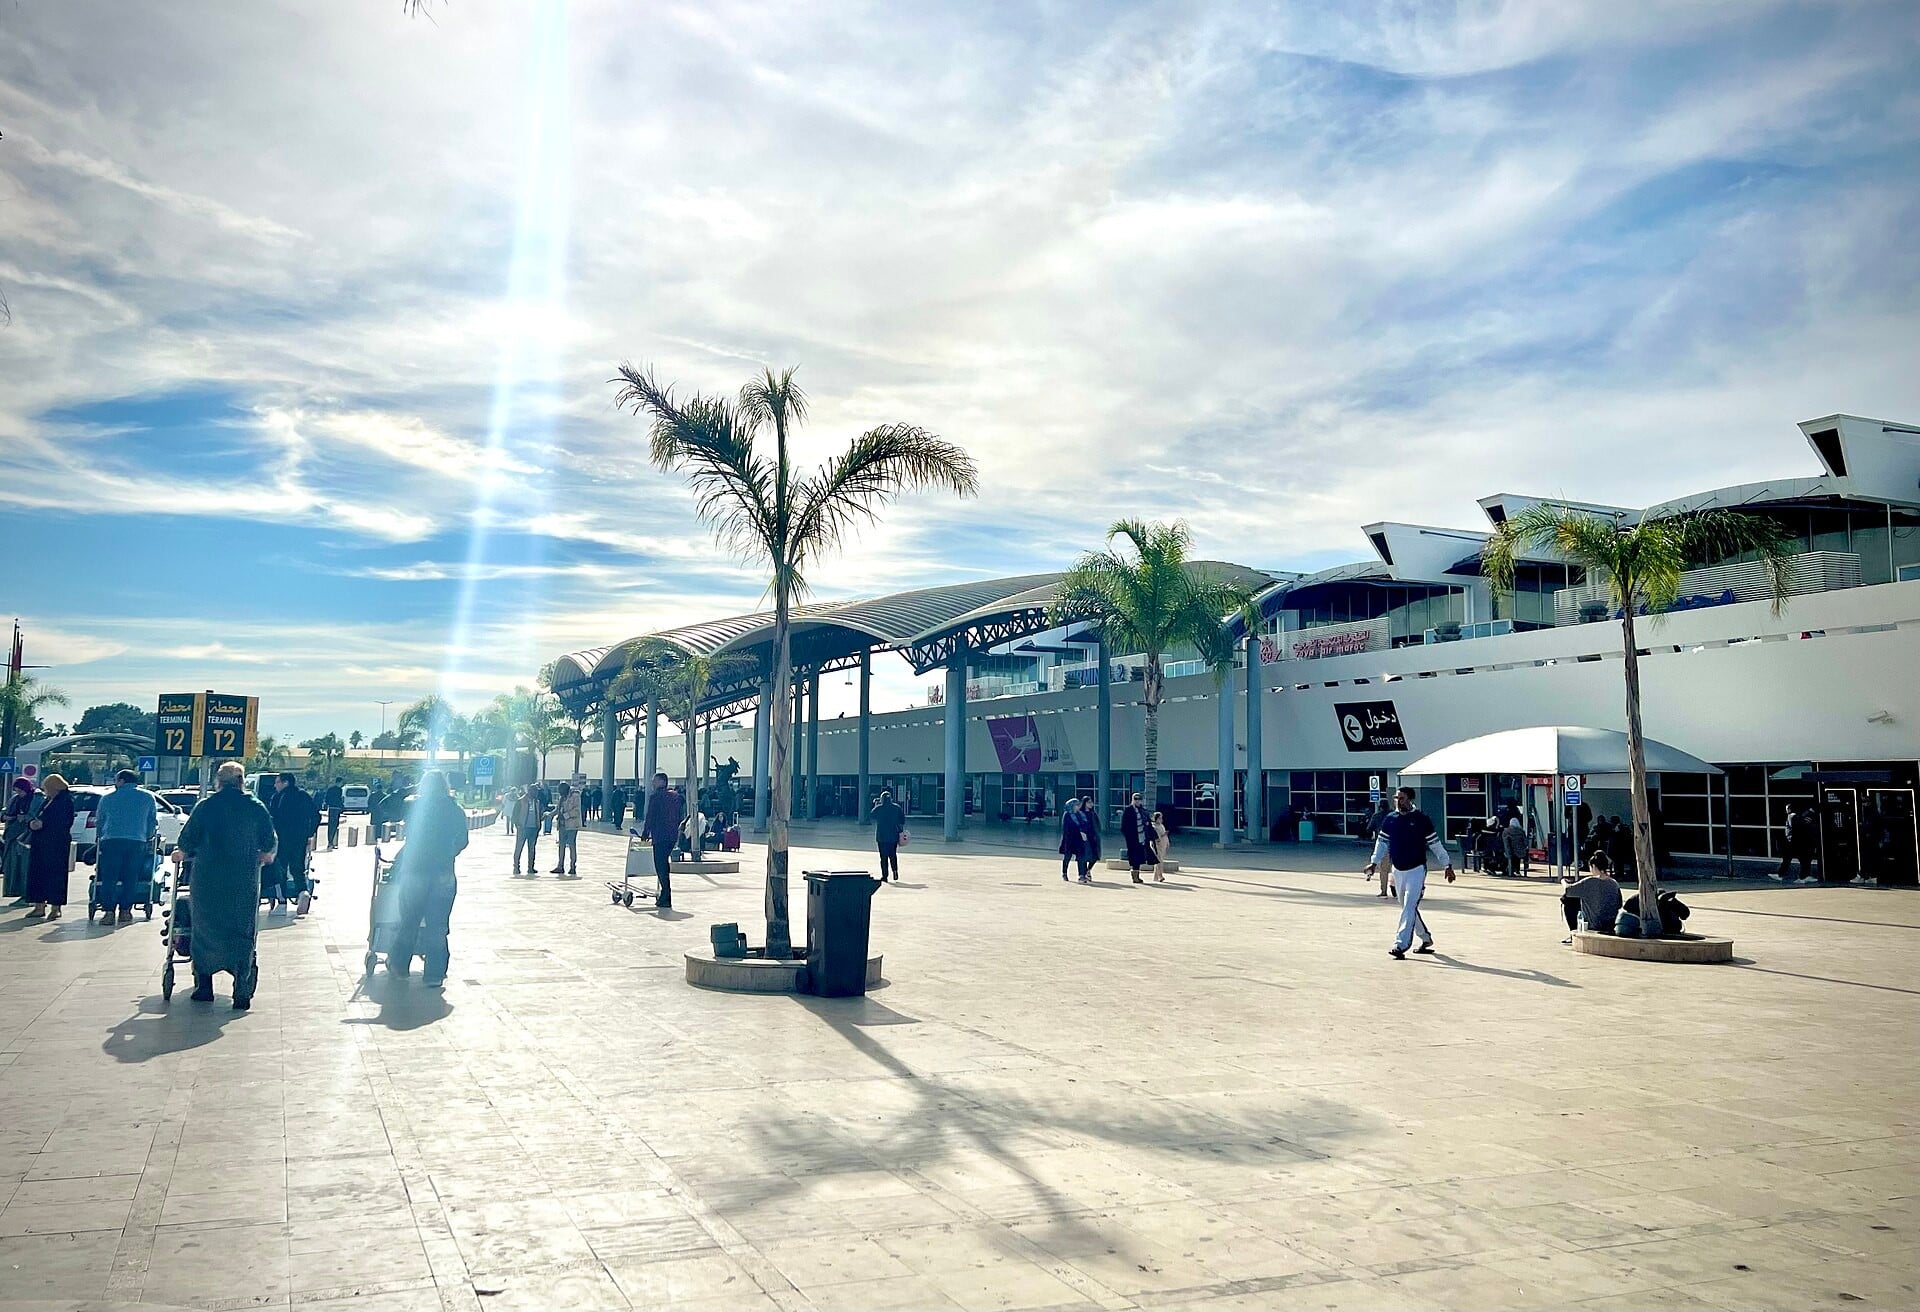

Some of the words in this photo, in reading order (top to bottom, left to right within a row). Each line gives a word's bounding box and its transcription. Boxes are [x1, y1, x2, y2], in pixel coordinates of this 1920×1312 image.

[1336, 642, 1365, 654] maroc
[160, 700, 192, 714] محطة
[208, 700, 243, 714] محطة
[160, 716, 191, 724] TERMINAL
[208, 716, 243, 725] TERMINAL
[1365, 708, 1397, 729] دخول
[165, 728, 185, 750] T2
[213, 729, 236, 751] T2
[1370, 735, 1404, 746] Entrance
